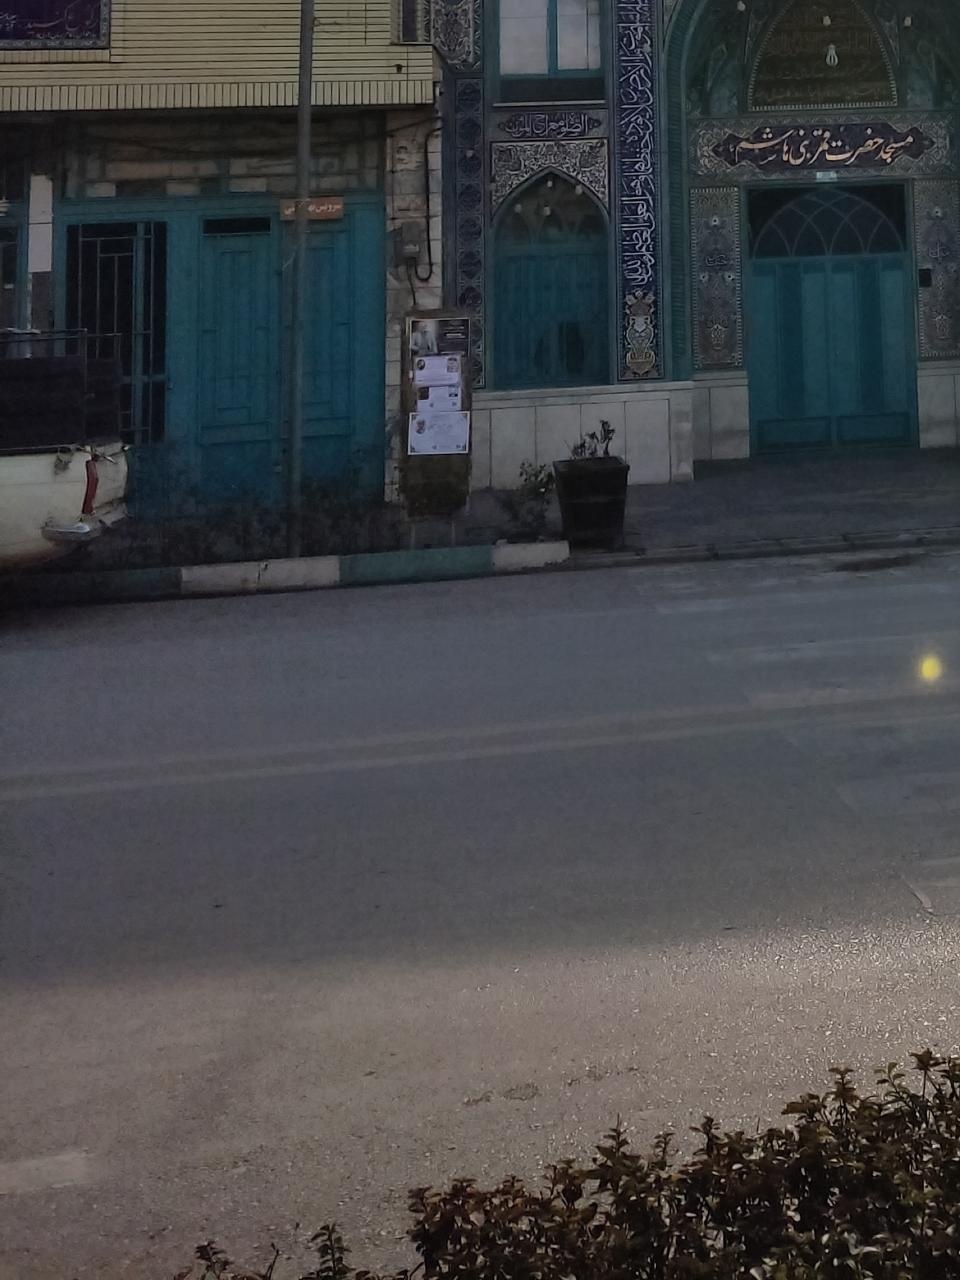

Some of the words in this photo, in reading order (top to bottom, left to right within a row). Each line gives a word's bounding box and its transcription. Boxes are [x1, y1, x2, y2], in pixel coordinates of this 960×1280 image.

[735, 127, 795, 164] هاشم
[788, 128, 810, 166] بنی
[808, 128, 831, 165] قمر
[825, 127, 885, 165] حضرت
[876, 135, 914, 164] مسجد
